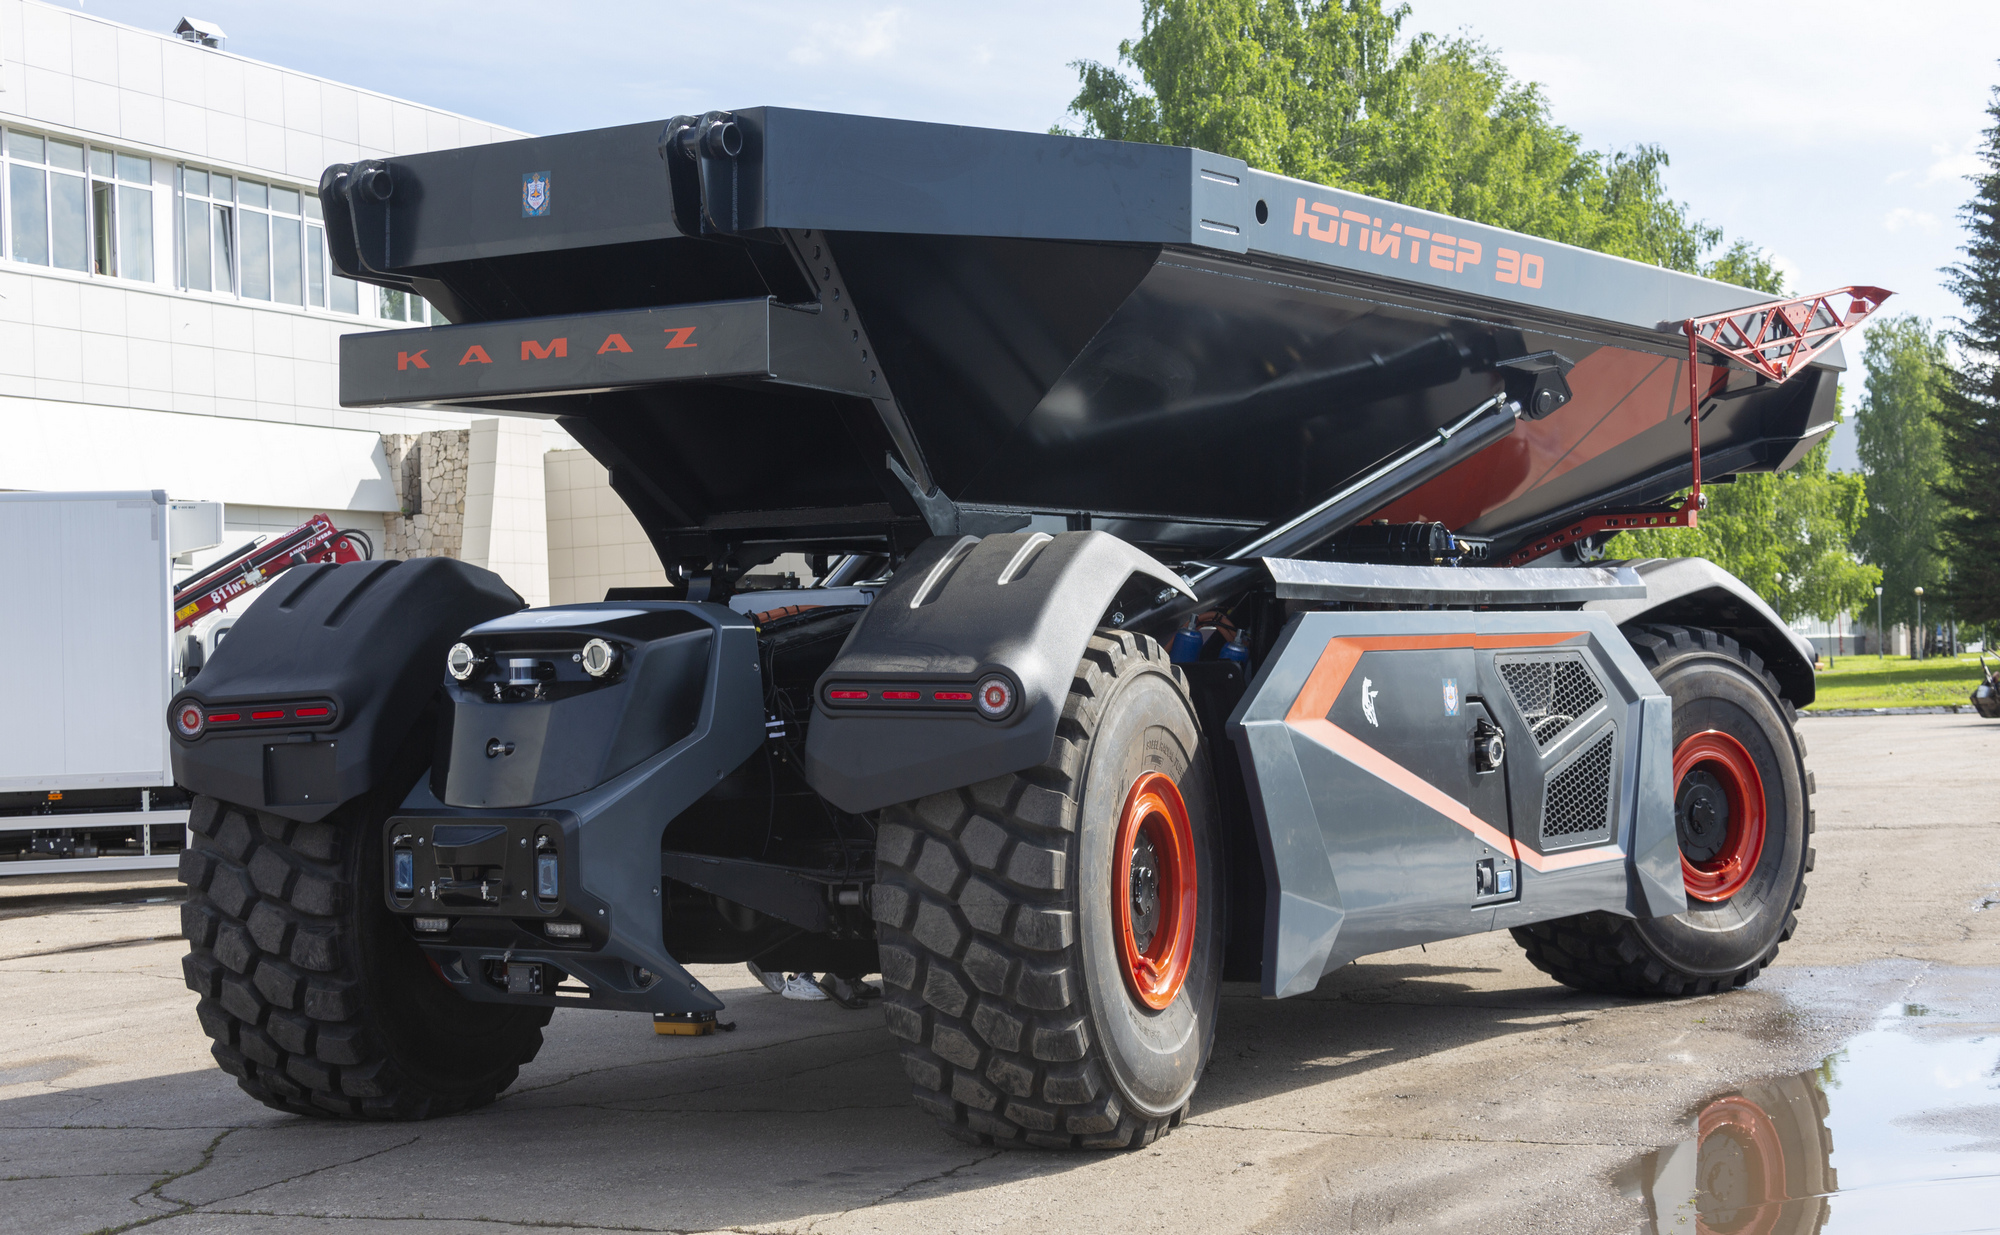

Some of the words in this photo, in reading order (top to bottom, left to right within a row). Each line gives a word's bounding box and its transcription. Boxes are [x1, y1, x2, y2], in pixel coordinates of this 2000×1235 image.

[1292, 197, 1483, 274] ЮПИТЕР
[1495, 247, 1545, 289] 30
[397, 326, 698, 371] KAMAZ
[316, 530, 333, 541] VEBA
